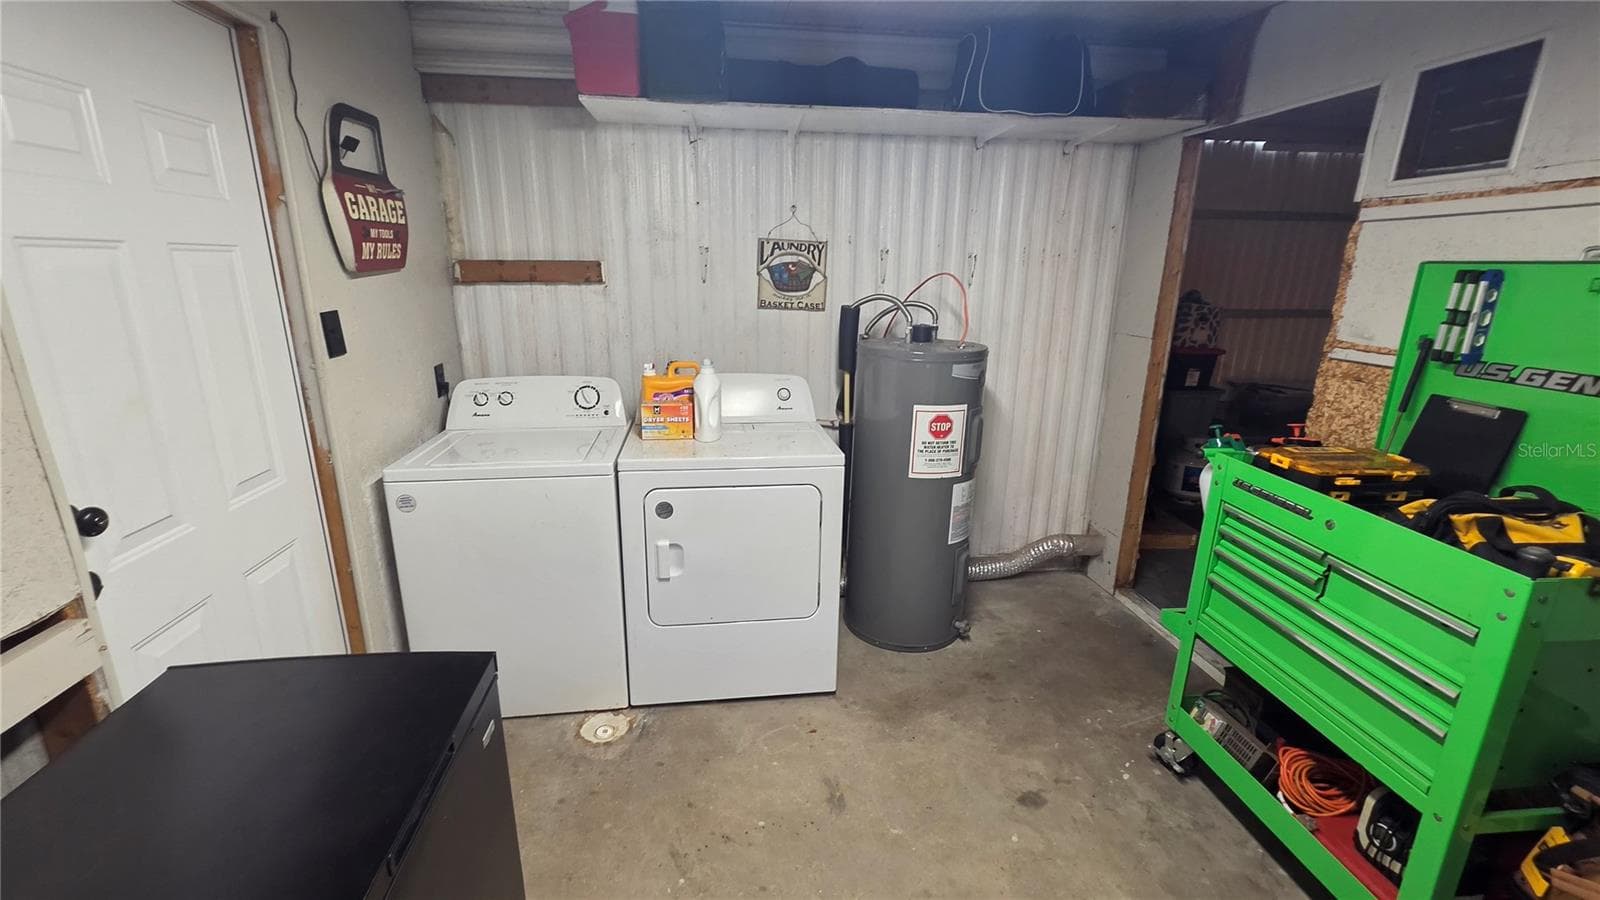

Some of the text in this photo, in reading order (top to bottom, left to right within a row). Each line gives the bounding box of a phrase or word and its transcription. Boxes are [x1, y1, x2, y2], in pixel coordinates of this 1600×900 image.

[344, 192, 406, 224] GARAGE
[370, 228, 394, 239] MY TOOLS
[362, 242, 402, 259] MY RULES
[760, 241, 825, 266] LAUNDRY
[760, 300, 794, 309] BASKET
[930, 422, 951, 432] STOP
